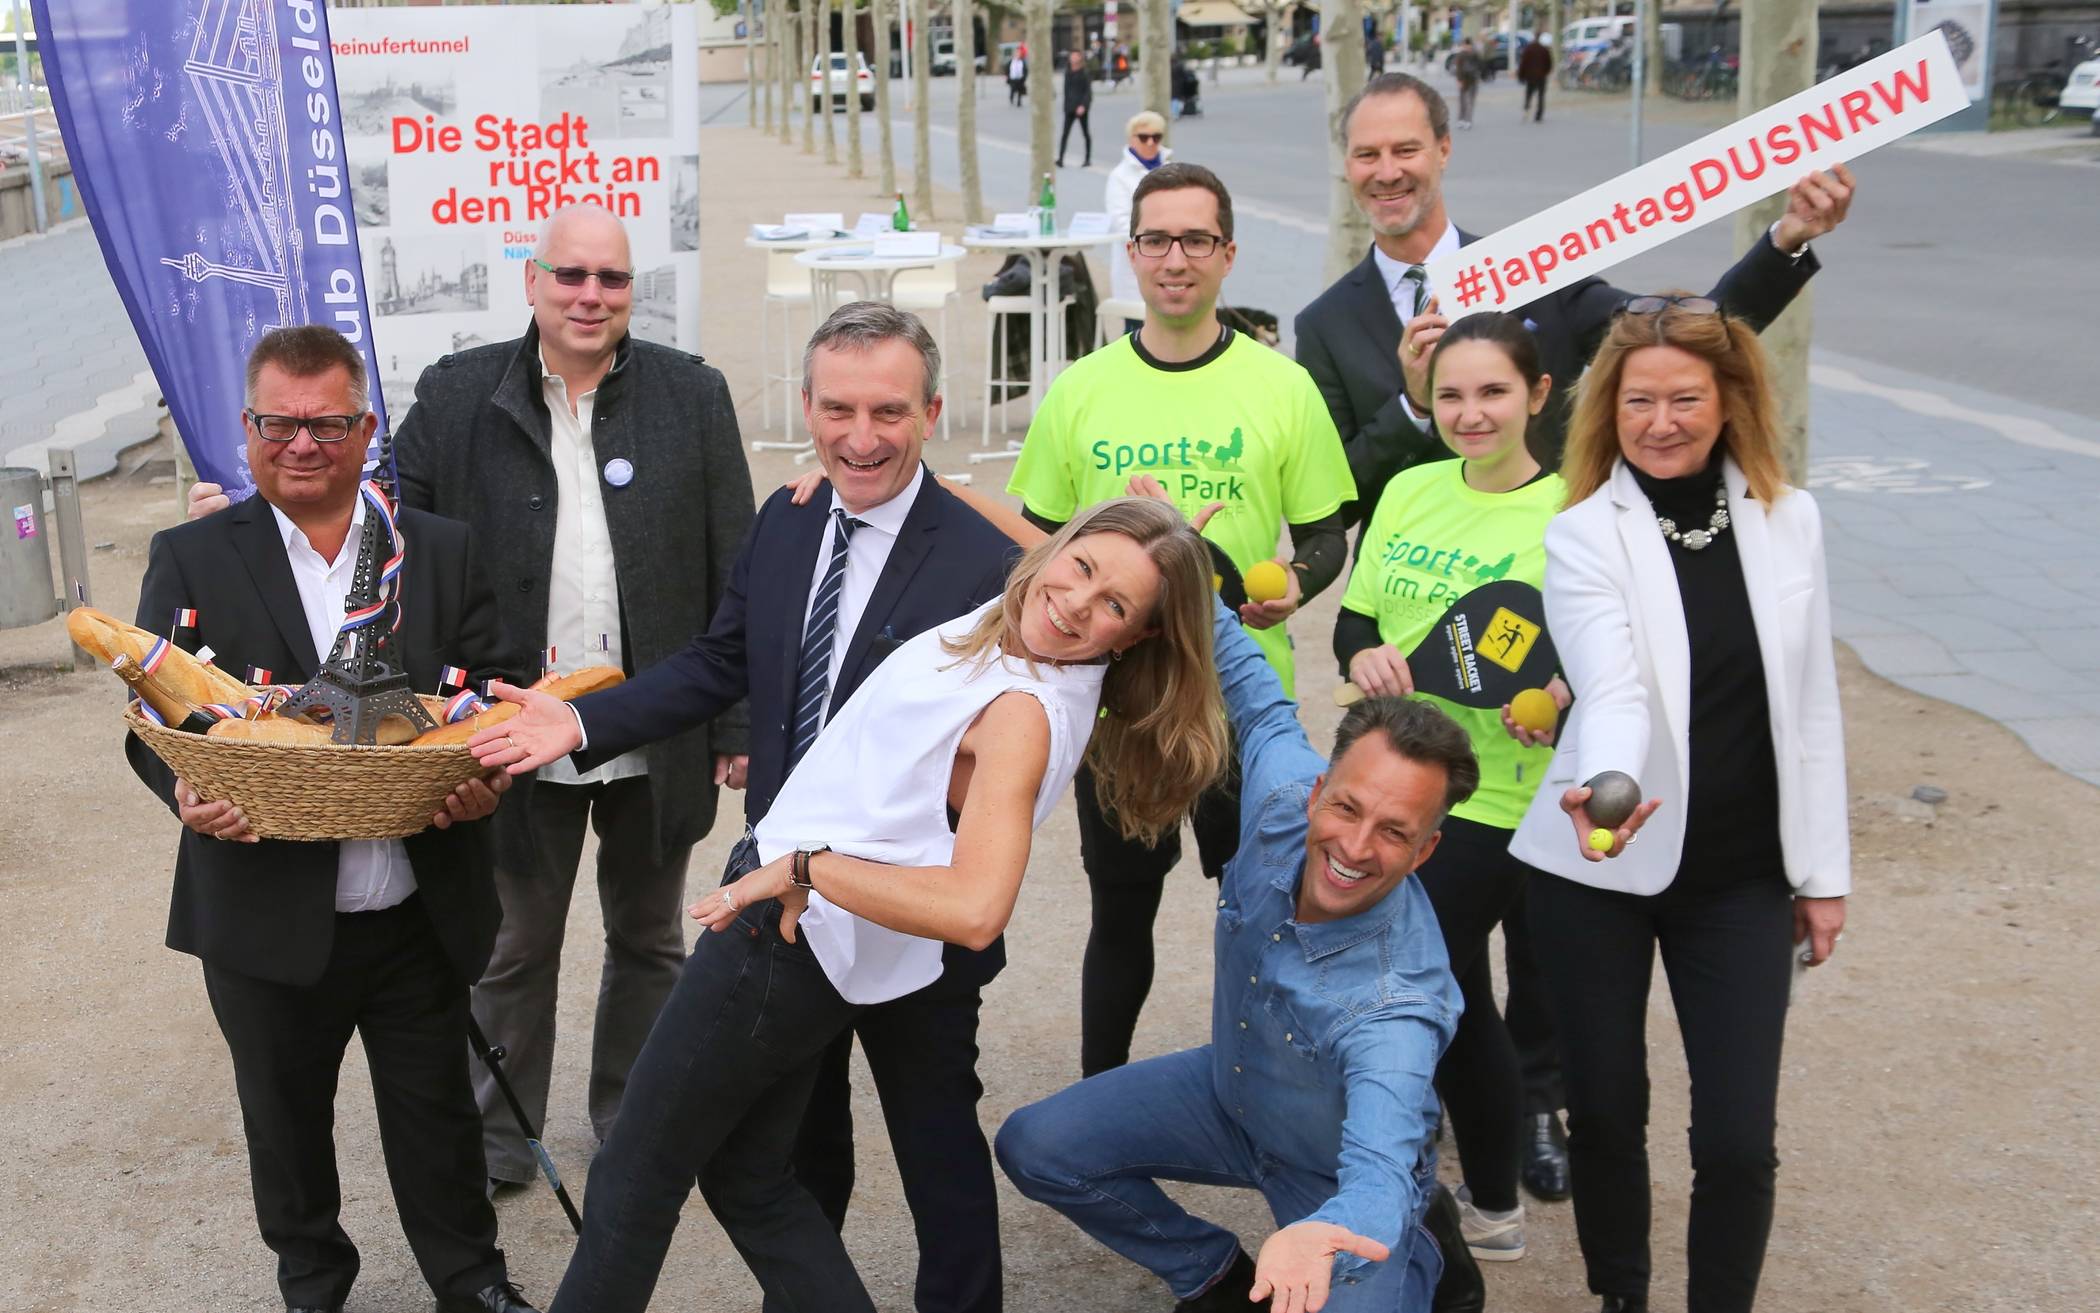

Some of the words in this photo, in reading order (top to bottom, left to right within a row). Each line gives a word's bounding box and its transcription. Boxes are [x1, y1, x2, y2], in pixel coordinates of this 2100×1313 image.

[392, 115, 462, 154] Die
[475, 112, 588, 150] Stadt
[490, 148, 600, 187] rückt
[612, 156, 659, 182] an
[1454, 58, 1931, 308] #japantagDUSNRW
[432, 188, 511, 224] den
[1092, 437, 1191, 476] Sport
[1181, 474, 1244, 500] Park
[1385, 569, 1419, 600] im
[1454, 613, 1473, 652] STREET
[1463, 653, 1482, 693] RACKET
